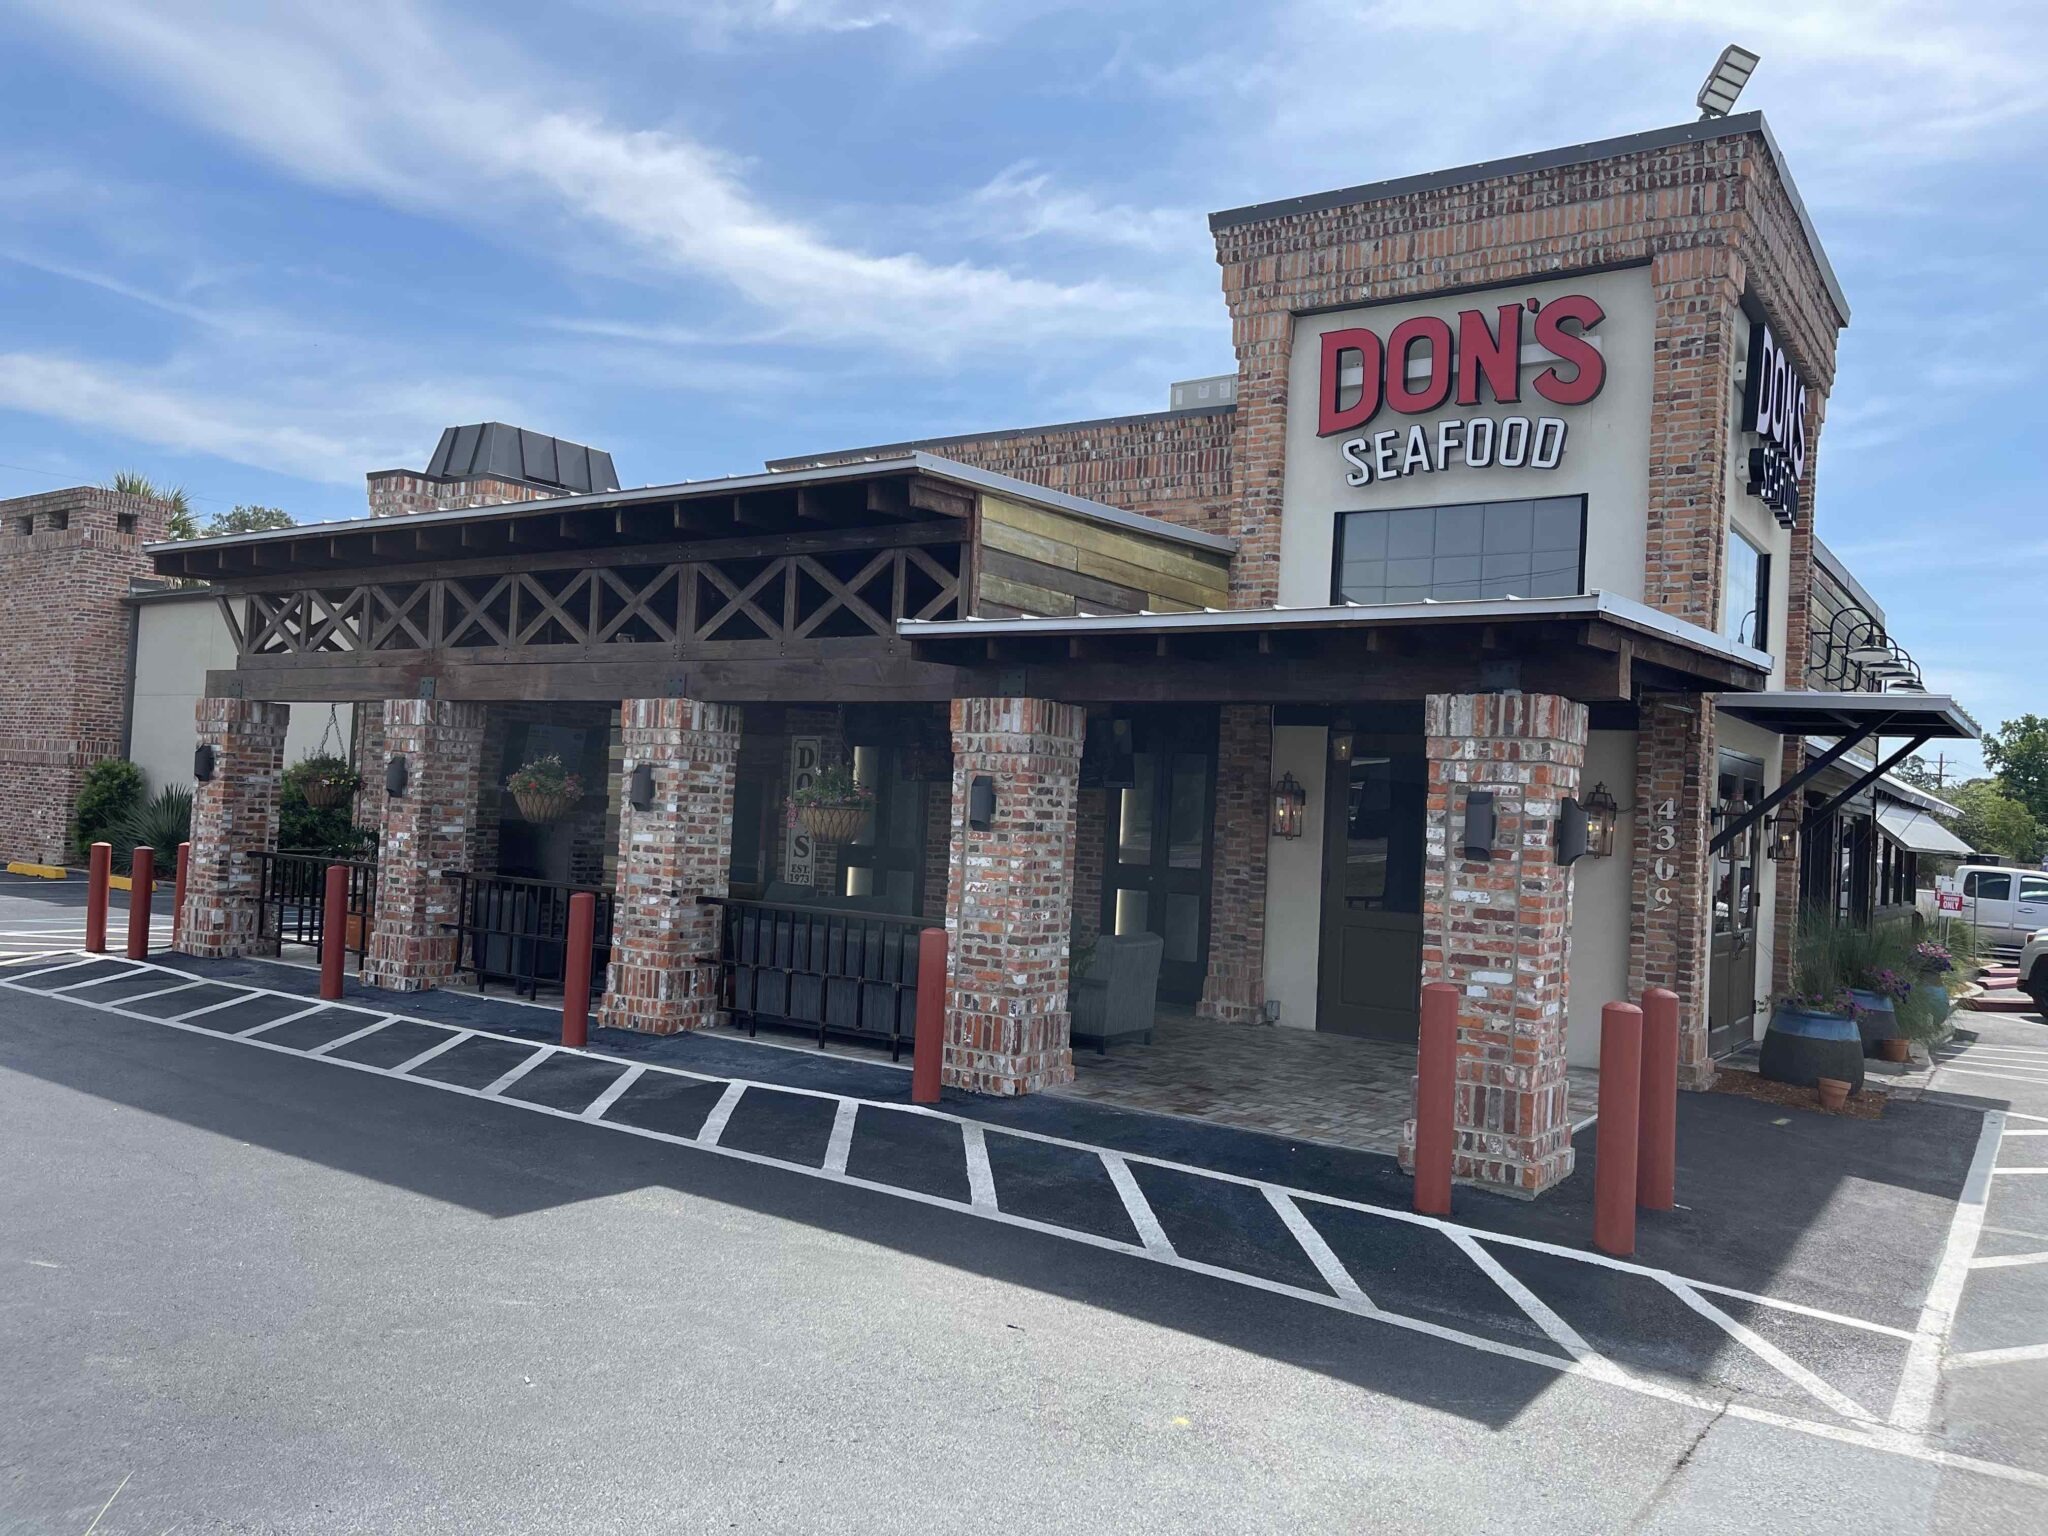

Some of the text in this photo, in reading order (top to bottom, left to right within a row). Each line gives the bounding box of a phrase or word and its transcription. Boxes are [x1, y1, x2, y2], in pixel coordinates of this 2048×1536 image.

[1316, 295, 1606, 438] DON'S
[1341, 416, 1569, 487] SEAFOOD
[790, 873, 810, 884] 1973
[1653, 797, 1677, 912] 4309
[1942, 901, 1960, 910] ONLY
